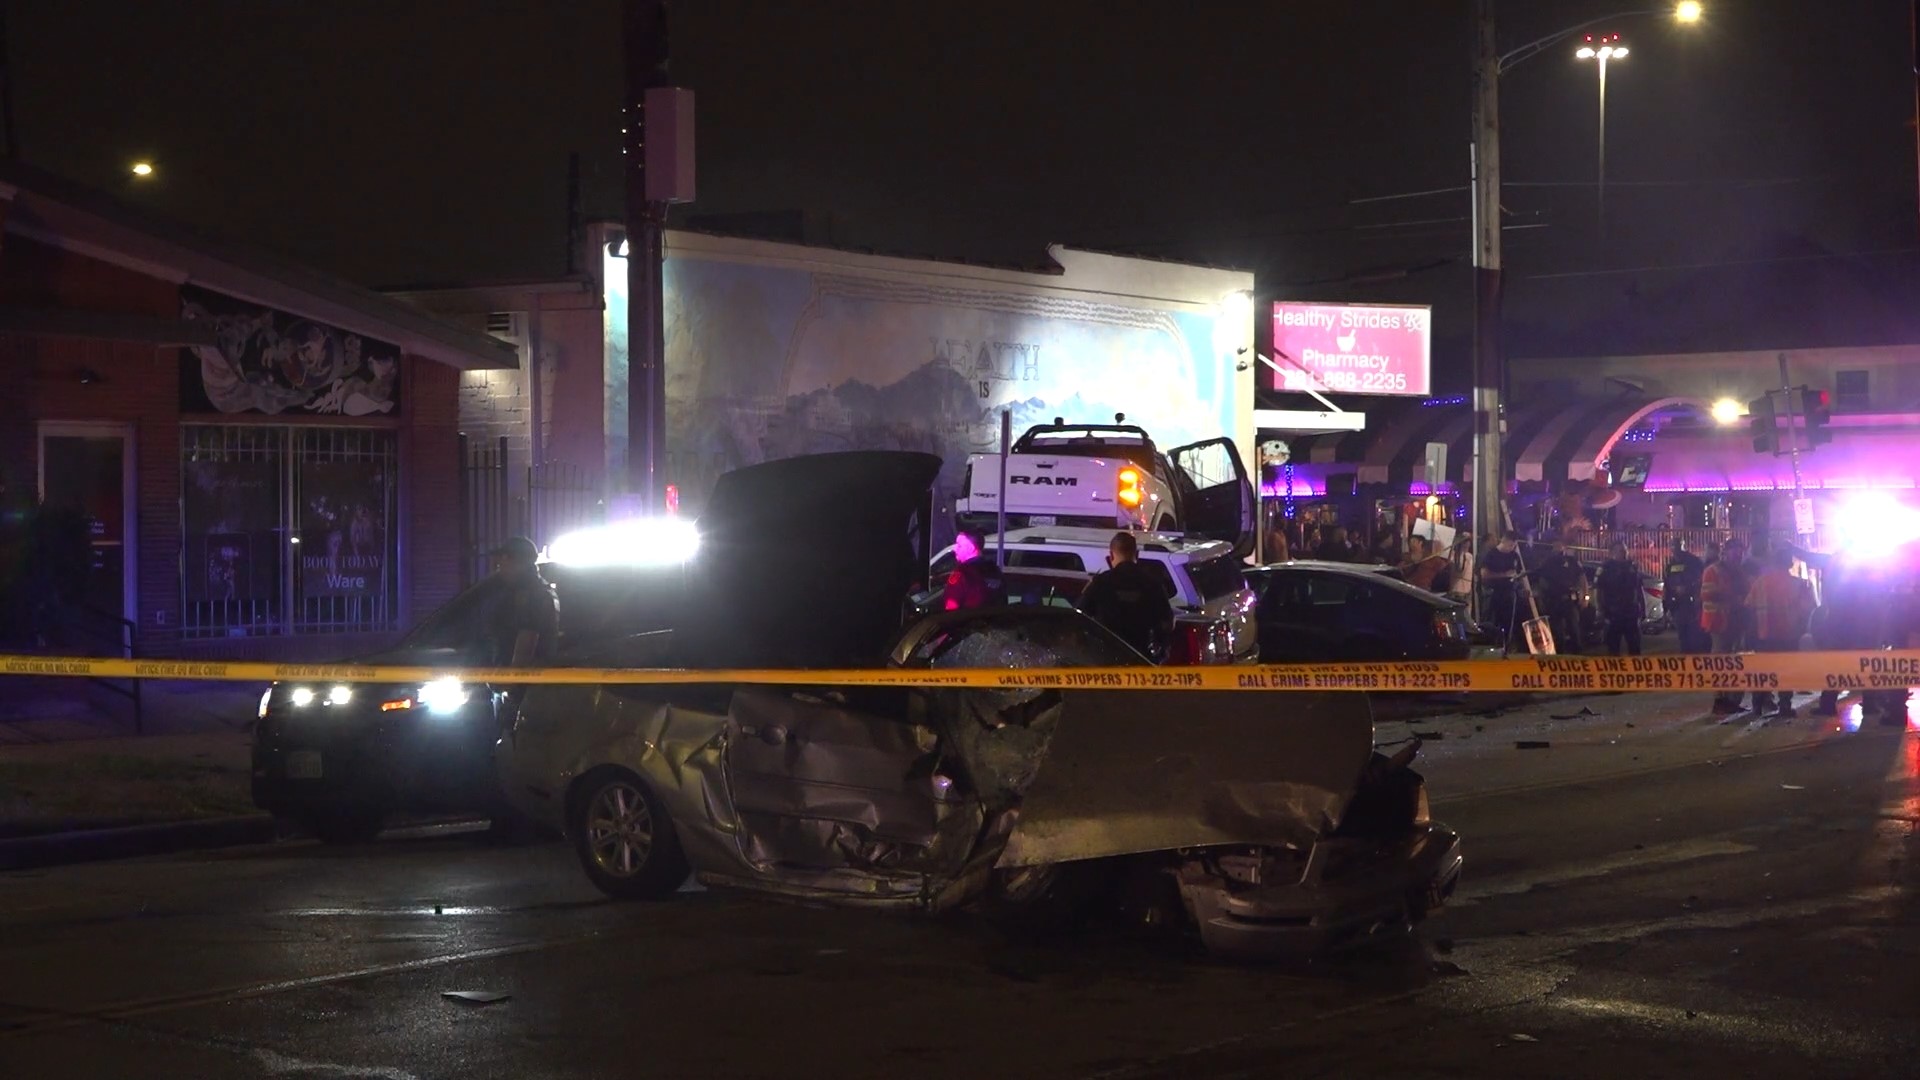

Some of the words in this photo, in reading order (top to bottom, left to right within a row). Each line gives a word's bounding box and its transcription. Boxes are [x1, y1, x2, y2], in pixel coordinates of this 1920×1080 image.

[1273, 308, 1336, 331] Healthy
[1341, 311, 1400, 329] Strides
[1302, 349, 1389, 372] Pharmacy
[979, 381, 990, 398] IS
[1010, 475, 1078, 487] RAM
[326, 574, 365, 589] Ware
[1538, 657, 1589, 672] POLICE
[1596, 657, 1627, 671] LINE
[1632, 657, 1651, 671] DO
[1658, 656, 1686, 671] NOT
[1693, 656, 1744, 671] CROSS
[1860, 657, 1920, 674] POLICE
[1066, 673, 1122, 685] STOPPERS
[1126, 672, 1203, 686] 713-222-TIPS
[1238, 674, 1267, 687] CALL
[1271, 674, 1309, 687] CRIME
[1314, 673, 1378, 687] STOPPERS
[1383, 672, 1470, 687] 713-222-TIPS
[1512, 674, 1544, 688] CALL
[1549, 674, 1594, 688] CRIME
[1600, 673, 1672, 688] STOPPERS
[1677, 672, 1778, 688] 713-222-TIPS
[1826, 673, 1865, 688] CALL
